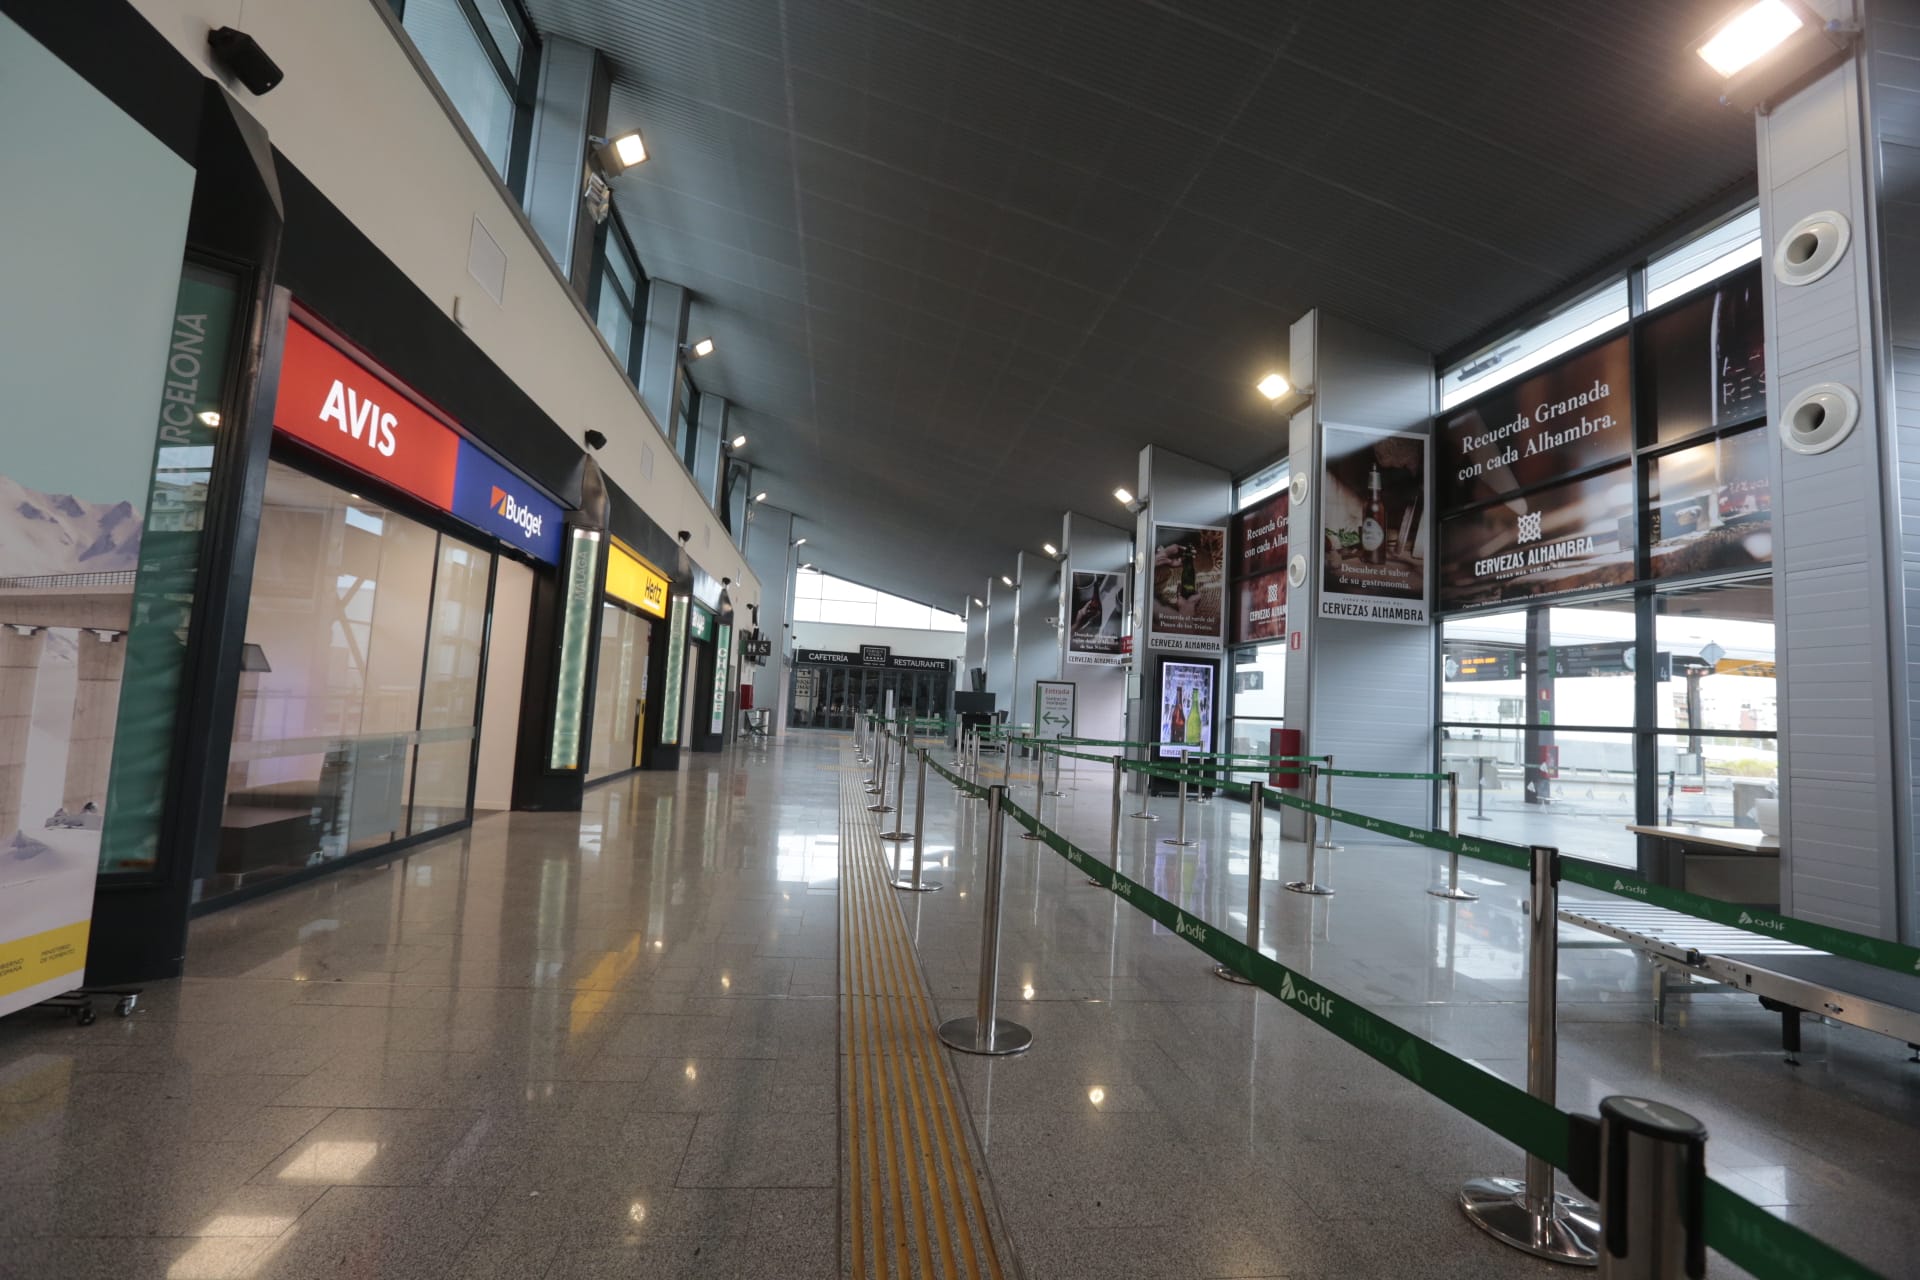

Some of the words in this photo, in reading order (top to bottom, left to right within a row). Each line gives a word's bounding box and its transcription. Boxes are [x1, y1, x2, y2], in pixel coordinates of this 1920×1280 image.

[159, 313, 209, 445] RCELONA
[318, 379, 399, 457] AVIS
[1462, 413, 1530, 454] Recuerda
[1535, 380, 1610, 424] Granada
[1458, 463, 1483, 481] con
[1486, 446, 1519, 471] cada
[1523, 414, 1617, 458] Alhambra.
[505, 495, 542, 538] Budget
[1247, 519, 1276, 541] Recuerda
[1244, 548, 1256, 559] con
[1256, 539, 1271, 555] cada
[1271, 532, 1288, 549] Alha
[1474, 551, 1525, 577] CERVEZAS
[1528, 536, 1595, 567] ALHAMBRA
[1339, 575, 1348, 584] de
[1341, 563, 1378, 575] Descubre
[1380, 567, 1387, 575] el
[1388, 568, 1410, 578] sabor
[644, 575, 662, 604] Hertz
[1249, 607, 1271, 622] CERVEZAS
[1322, 602, 1369, 617] CERVEZAS
[1371, 605, 1424, 622] ALHAMBRA
[1150, 639, 1183, 649] CERVEZAS
[1185, 641, 1220, 651] ALHAMBRA
[808, 651, 849, 663] CAFETERÍA
[893, 658, 945, 669] RESTAURANTE
[1068, 655, 1093, 664] CERVEZAS
[1094, 657, 1121, 665] ALHAMBRA
[1556, 663, 1563, 674] 4
[1503, 665, 1509, 677] 5
[1660, 668, 1668, 680] 4
[1625, 886, 1649, 896] adif
[1185, 920, 1208, 944] adif
[1754, 918, 1786, 932] adif
[1296, 989, 1336, 1020] adif
